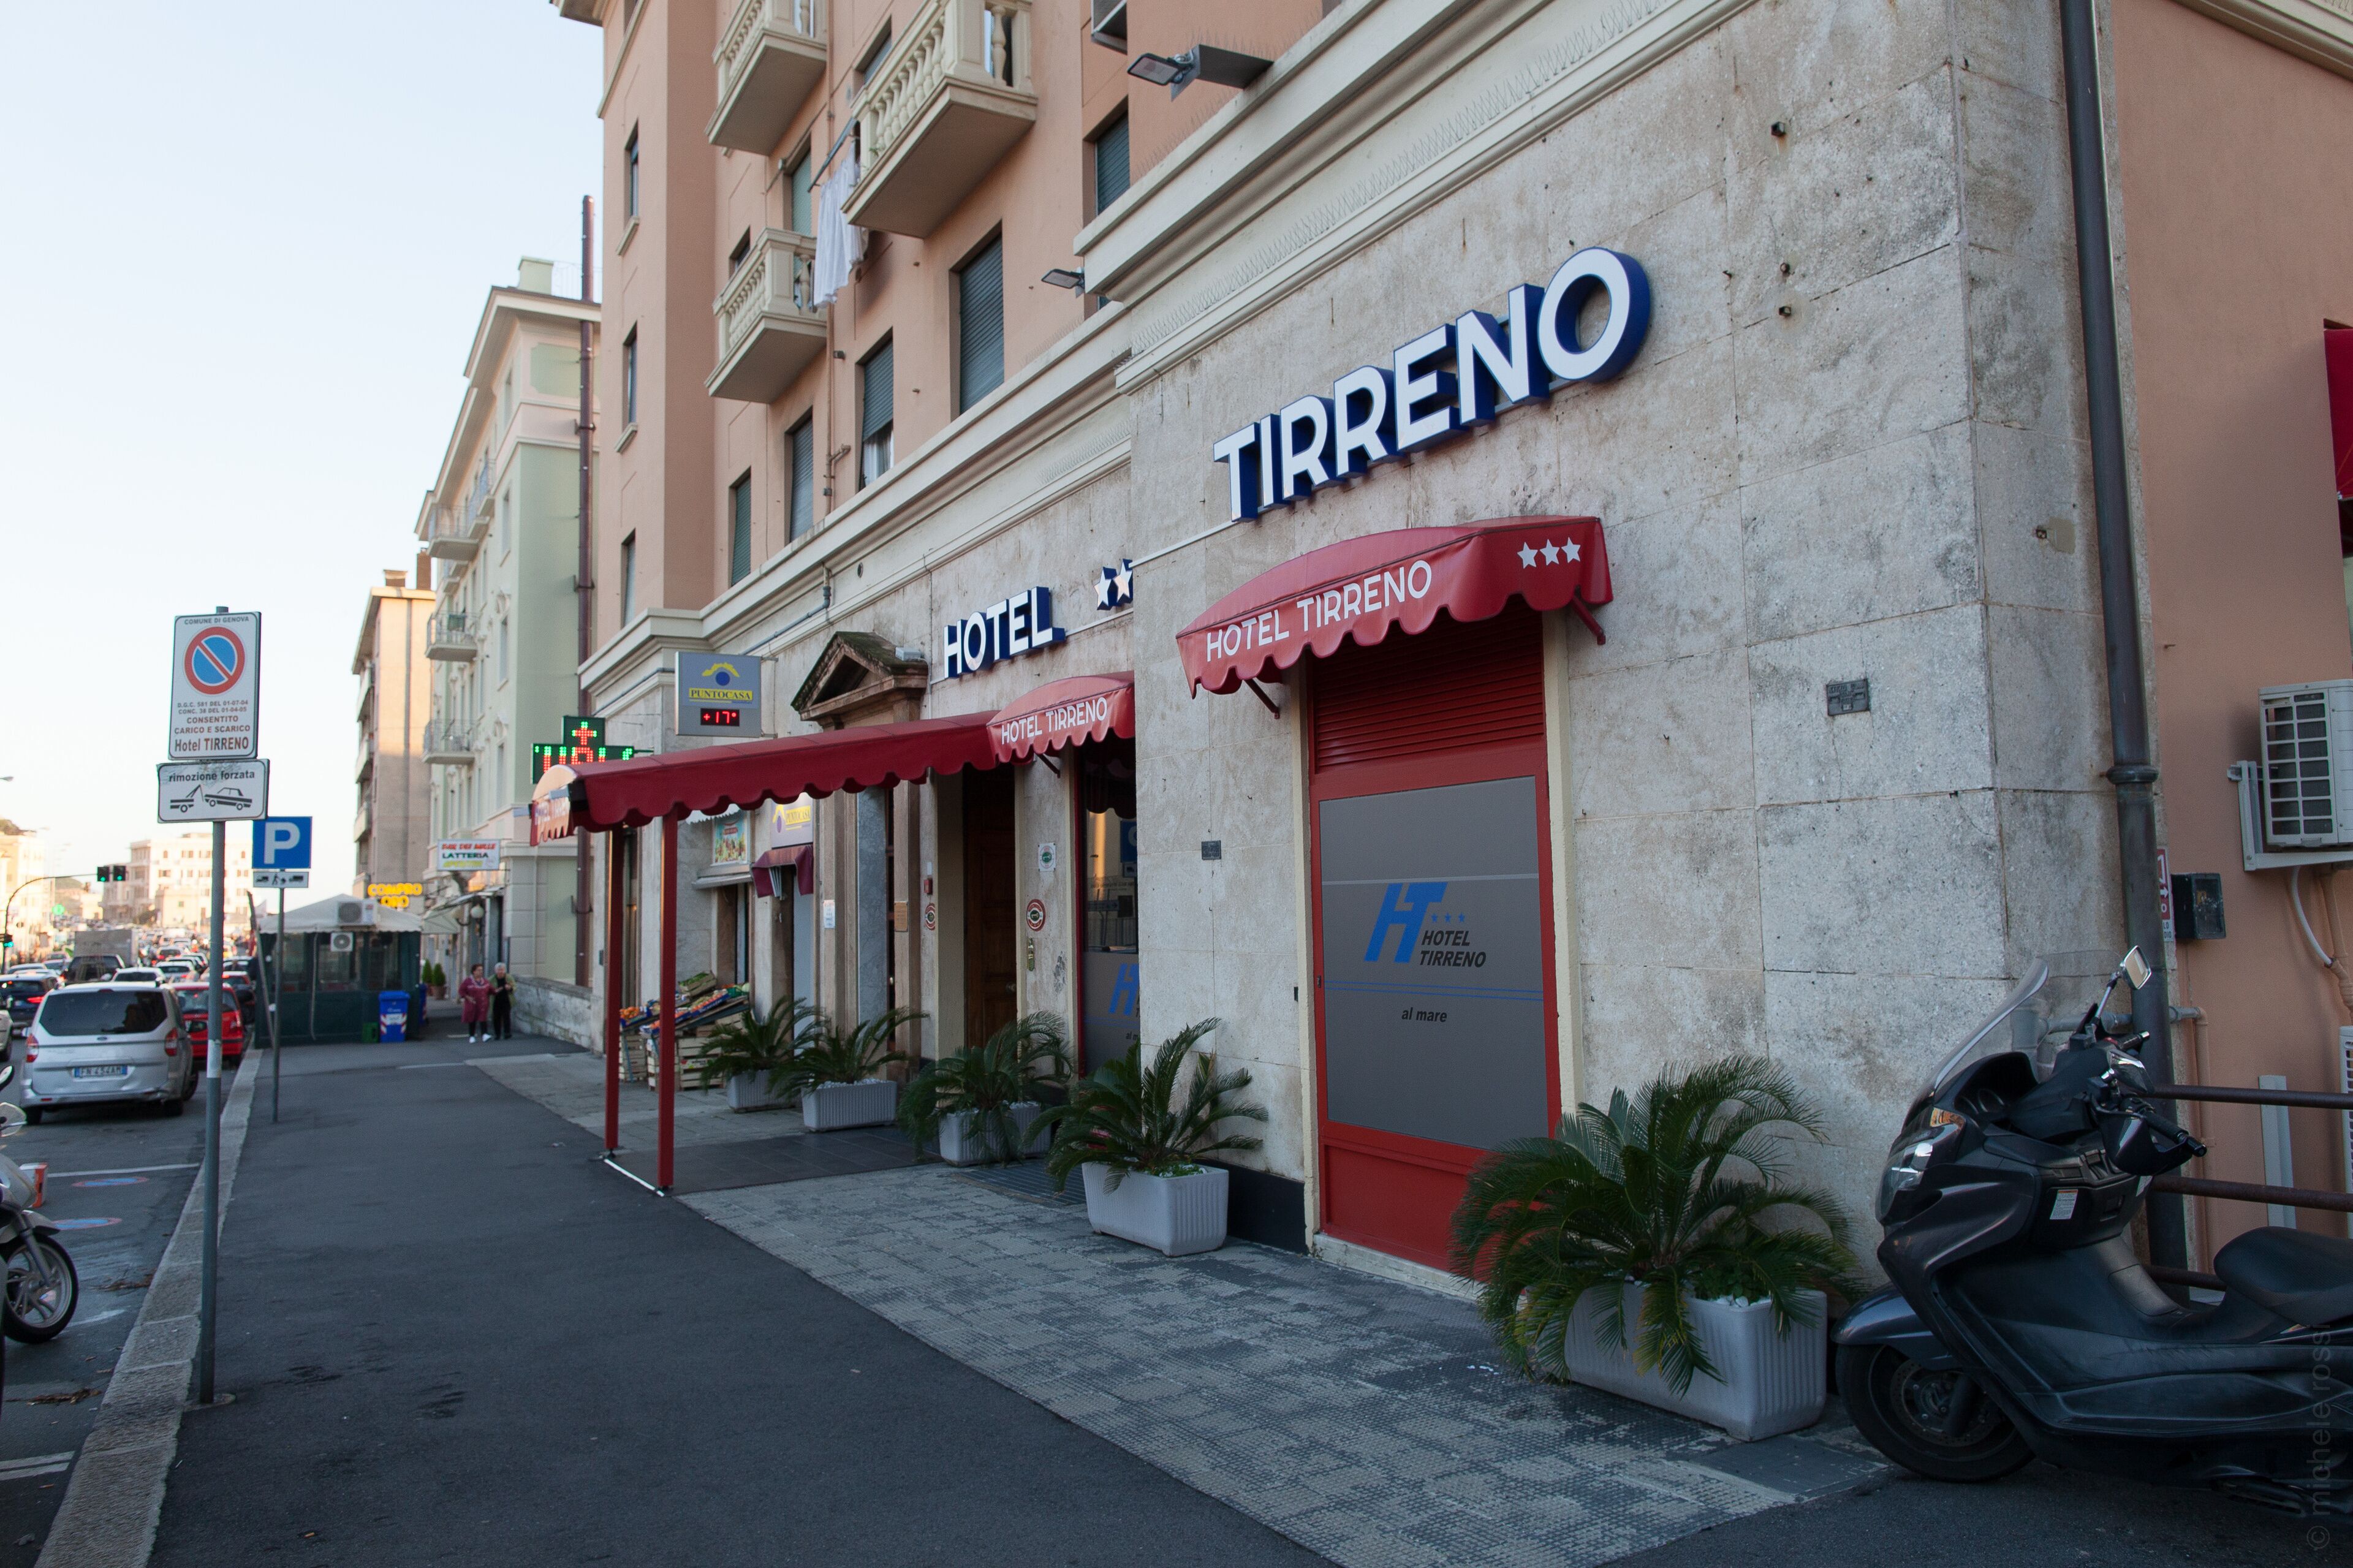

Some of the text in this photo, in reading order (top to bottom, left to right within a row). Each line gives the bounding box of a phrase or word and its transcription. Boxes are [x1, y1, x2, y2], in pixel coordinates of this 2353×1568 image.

[1213, 247, 1639, 523] TIRRENO
[1206, 559, 1433, 662] HOTEL TIRRENO
[943, 586, 1059, 679] HOTEL
[691, 689, 751, 700] PUNTOCASA
[186, 715, 239, 724] CONSENTITO
[1001, 697, 1107, 745] HOTEL TIRRENO
[174, 736, 249, 752] Hotel TIRRENO
[169, 770, 255, 782] rimozione forzata
[263, 822, 300, 865] P
[1421, 930, 1471, 947] HOTEL
[1419, 950, 1487, 968] TIRRENO
[1401, 1007, 1448, 1023] al mare
